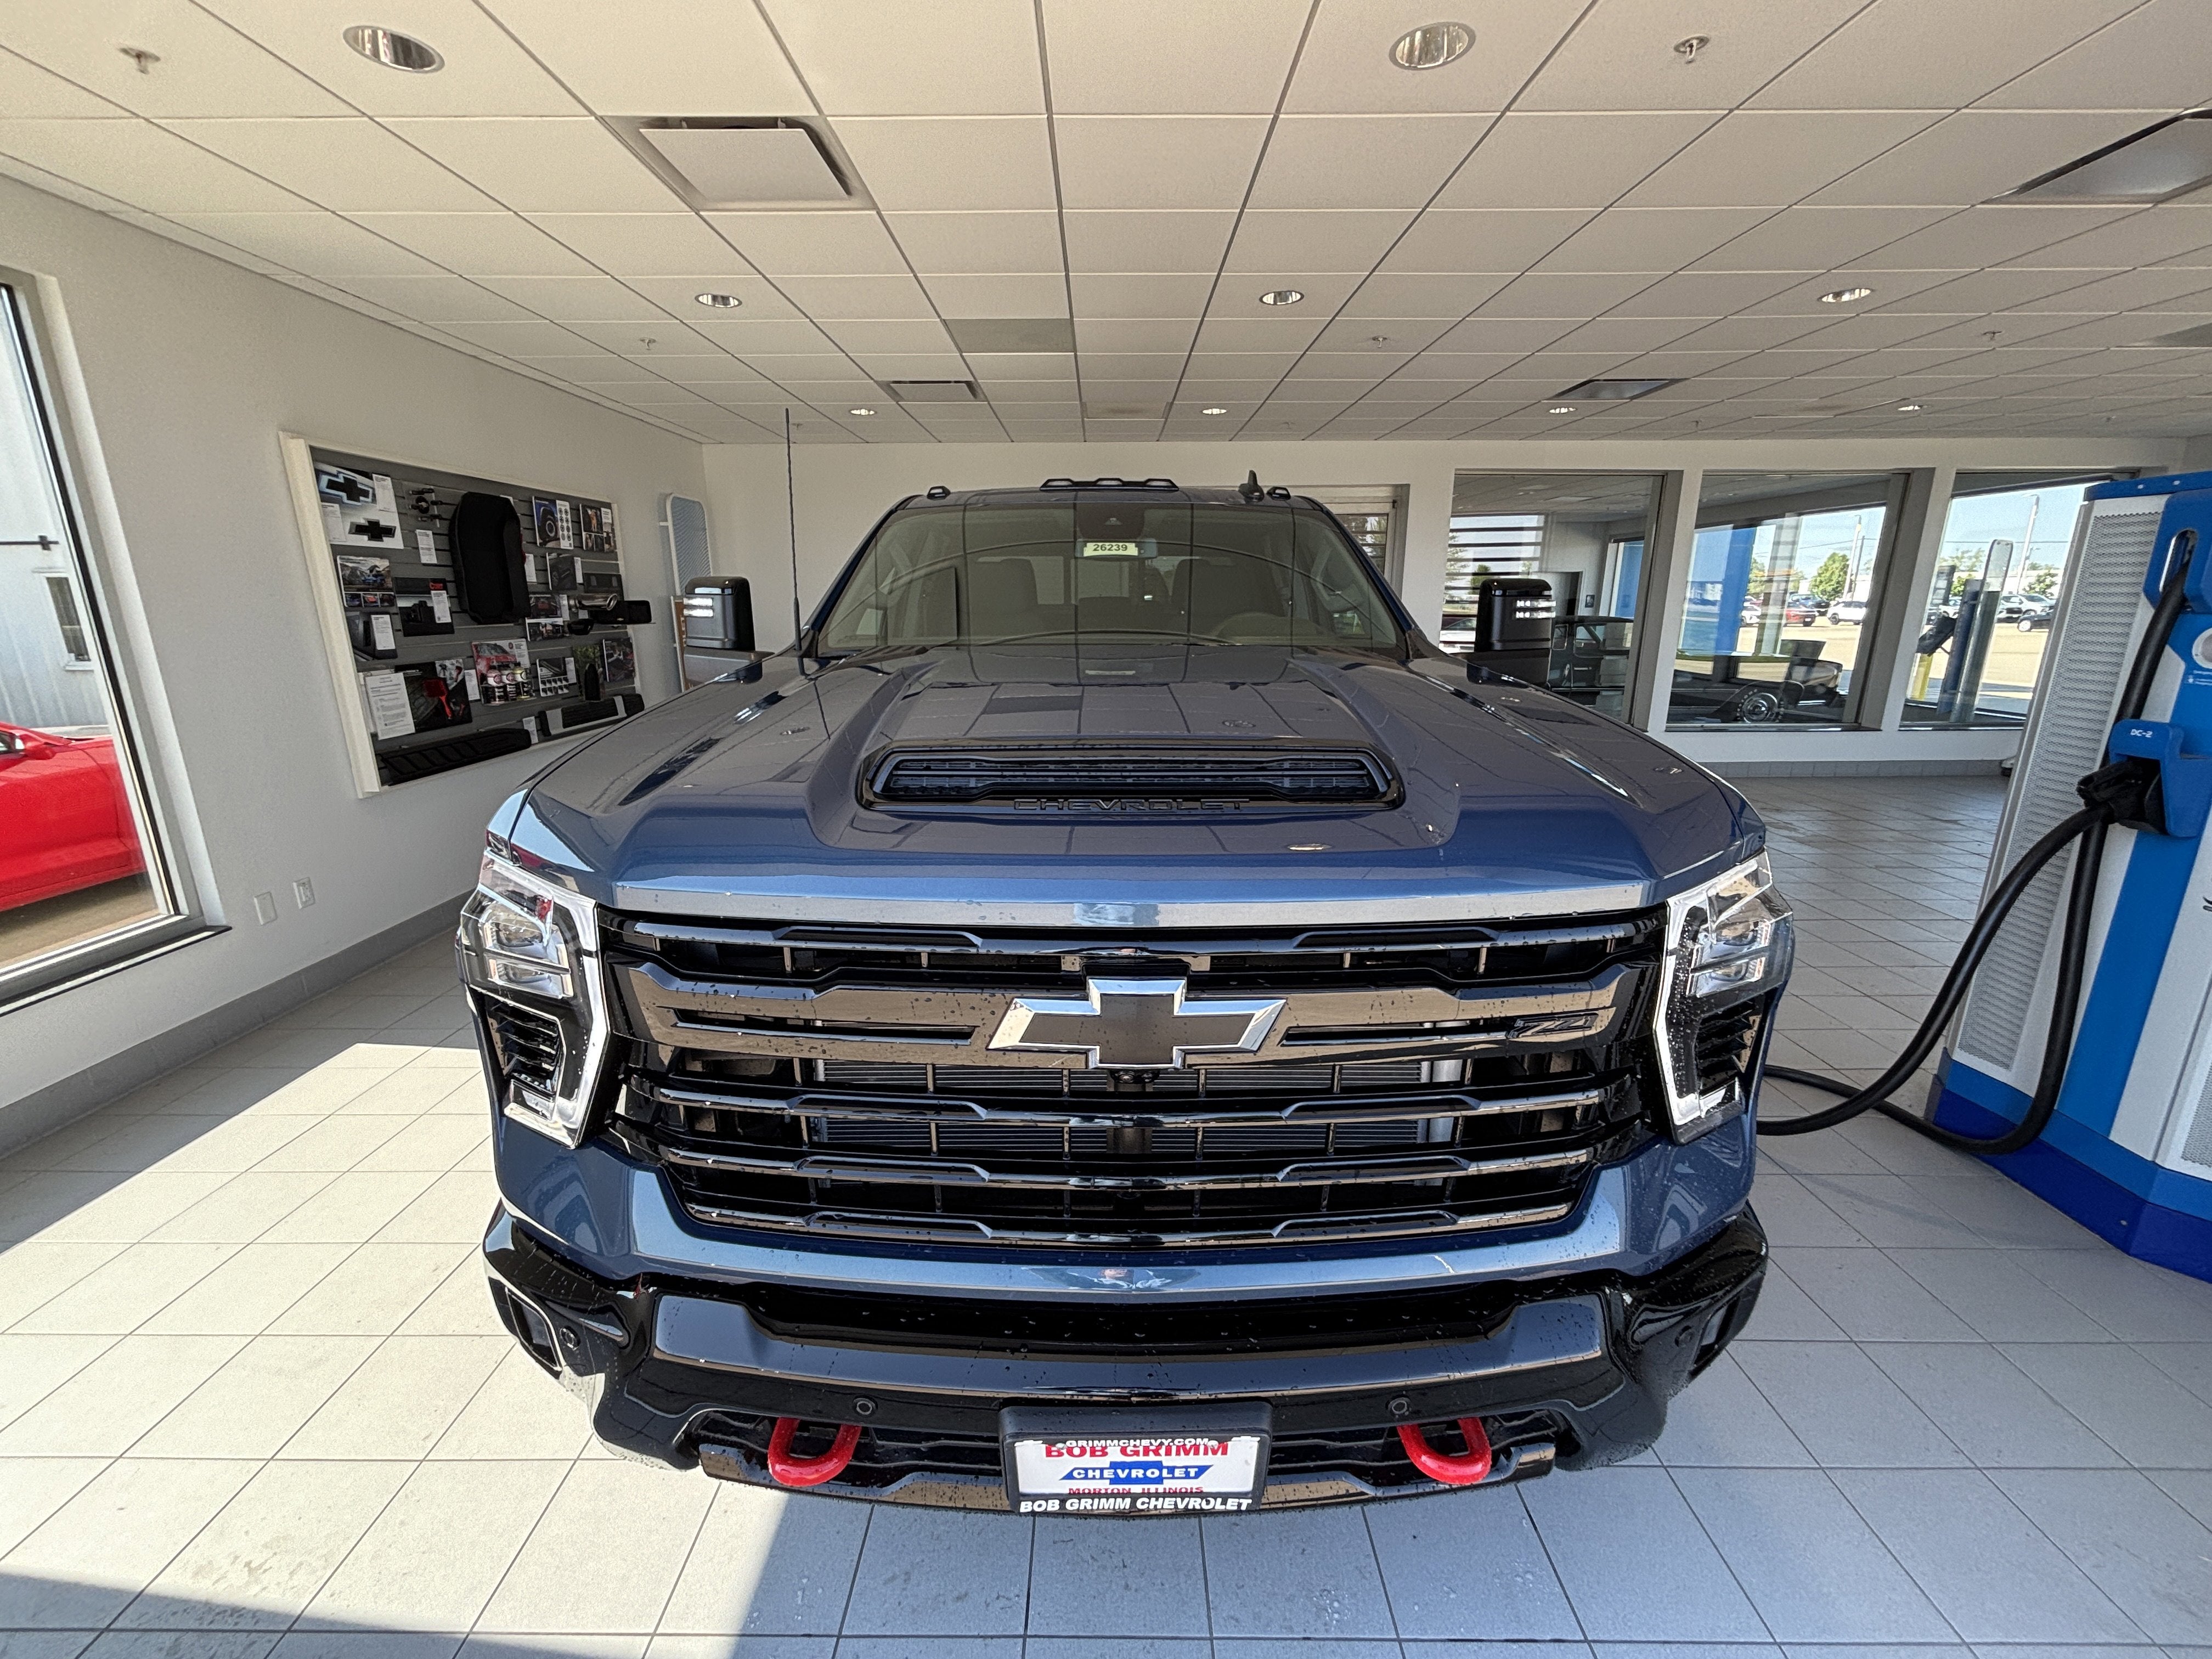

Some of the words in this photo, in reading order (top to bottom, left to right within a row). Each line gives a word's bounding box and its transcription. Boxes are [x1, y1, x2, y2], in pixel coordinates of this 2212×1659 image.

[1092, 543, 1128, 552] 26239
[2130, 729, 2153, 738] DC-2
[1014, 798, 1250, 811] CHEVROLET
[1065, 1438, 1209, 1448] GRIMMCHEVY.COM
[1045, 1444, 1109, 1458] BOB
[1120, 1442, 1229, 1457] GRIMM
[1072, 1468, 1199, 1479] CHEVROLET
[1019, 1499, 1060, 1513] BOB
[1065, 1497, 1131, 1510] GRIMM
[1136, 1497, 1253, 1511] CHEVROLET
